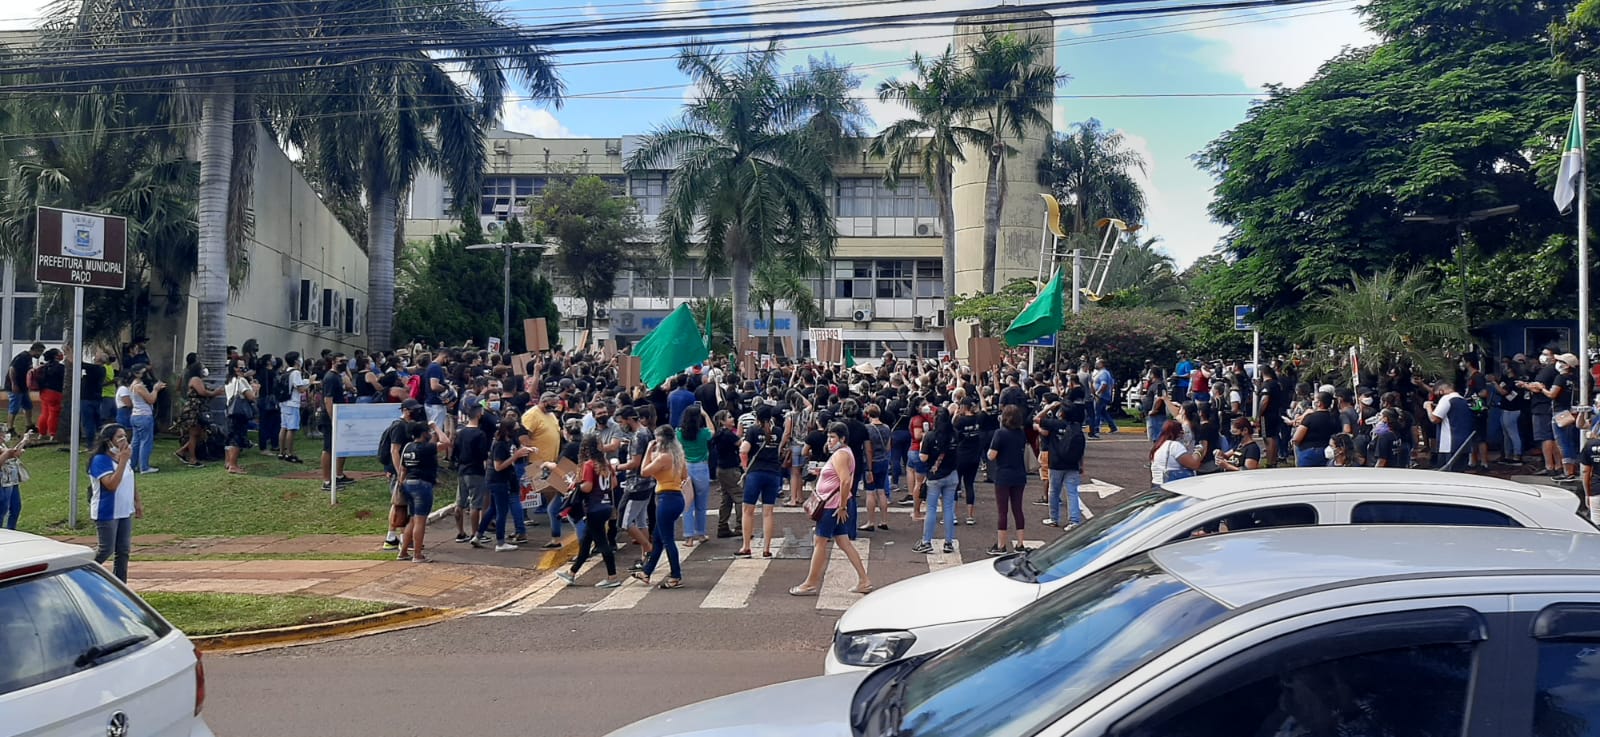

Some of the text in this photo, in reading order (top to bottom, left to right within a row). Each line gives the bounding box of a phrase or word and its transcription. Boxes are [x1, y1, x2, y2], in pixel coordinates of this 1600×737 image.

[39, 254, 123, 274] PREFEITURA MUNICIPAL
[71, 270, 91, 285] PAÇO
